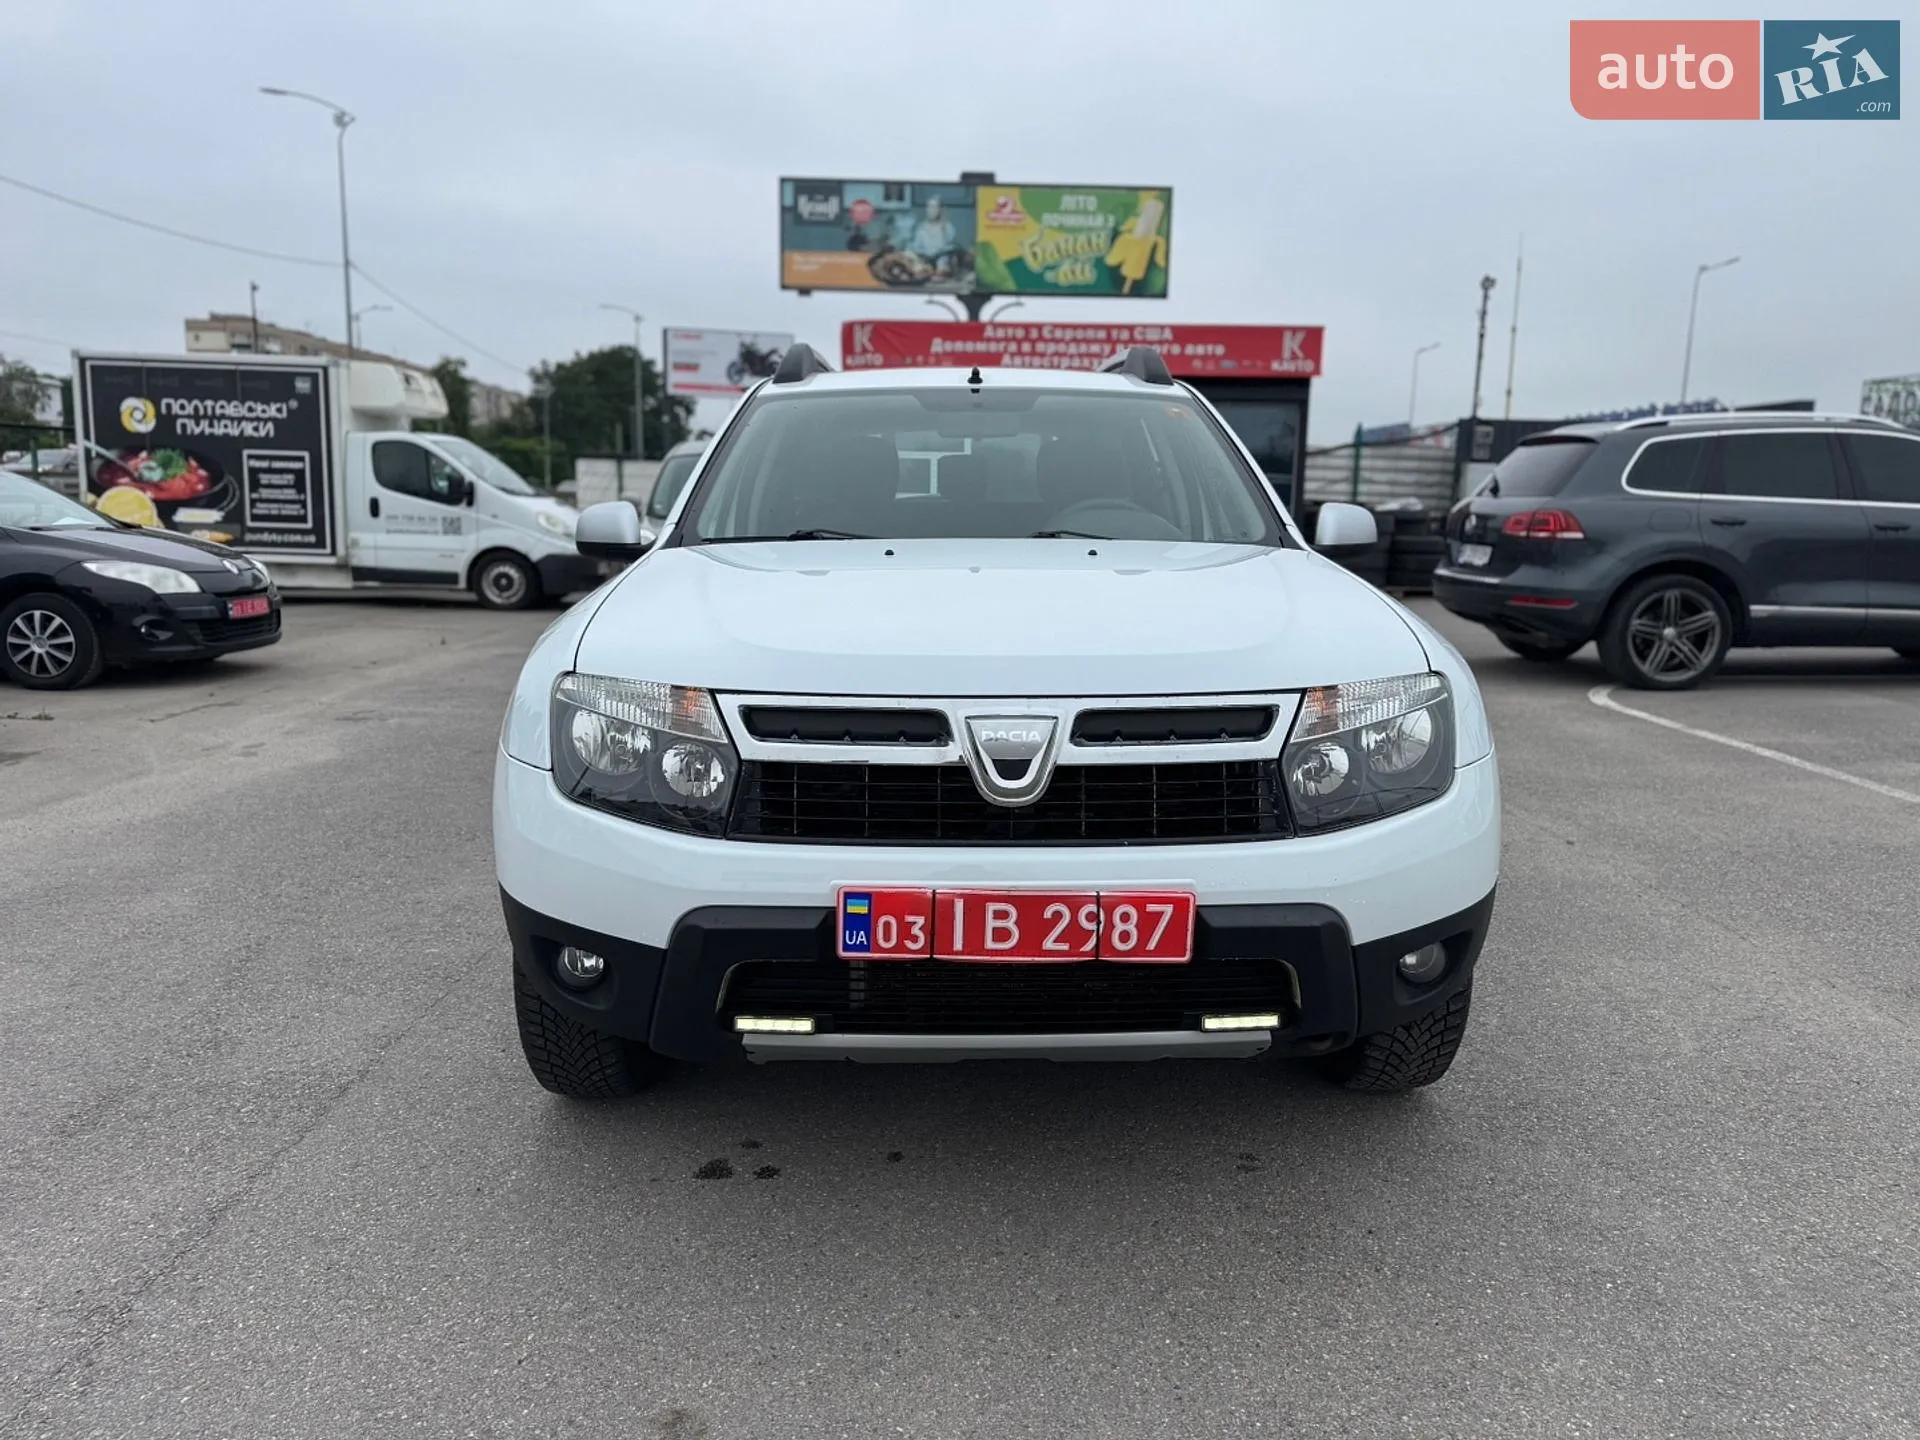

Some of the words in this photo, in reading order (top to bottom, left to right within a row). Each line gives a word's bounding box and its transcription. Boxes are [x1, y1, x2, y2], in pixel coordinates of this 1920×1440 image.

[1060, 194, 1098, 212] ЛІТО
[1110, 327, 1130, 340] та
[1132, 326, 1174, 341] США
[930, 337, 1018, 355] Допомога
[1184, 343, 1226, 356] авто
[160, 397, 288, 420] ПОЛТАВСЬКІ
[175, 417, 276, 438] ПУНДИКИ
[981, 730, 1042, 742] DACIA
[875, 914, 926, 951] 03
[952, 898, 1021, 951] IB
[1041, 902, 1175, 952] 2987
[844, 929, 868, 946] UA
